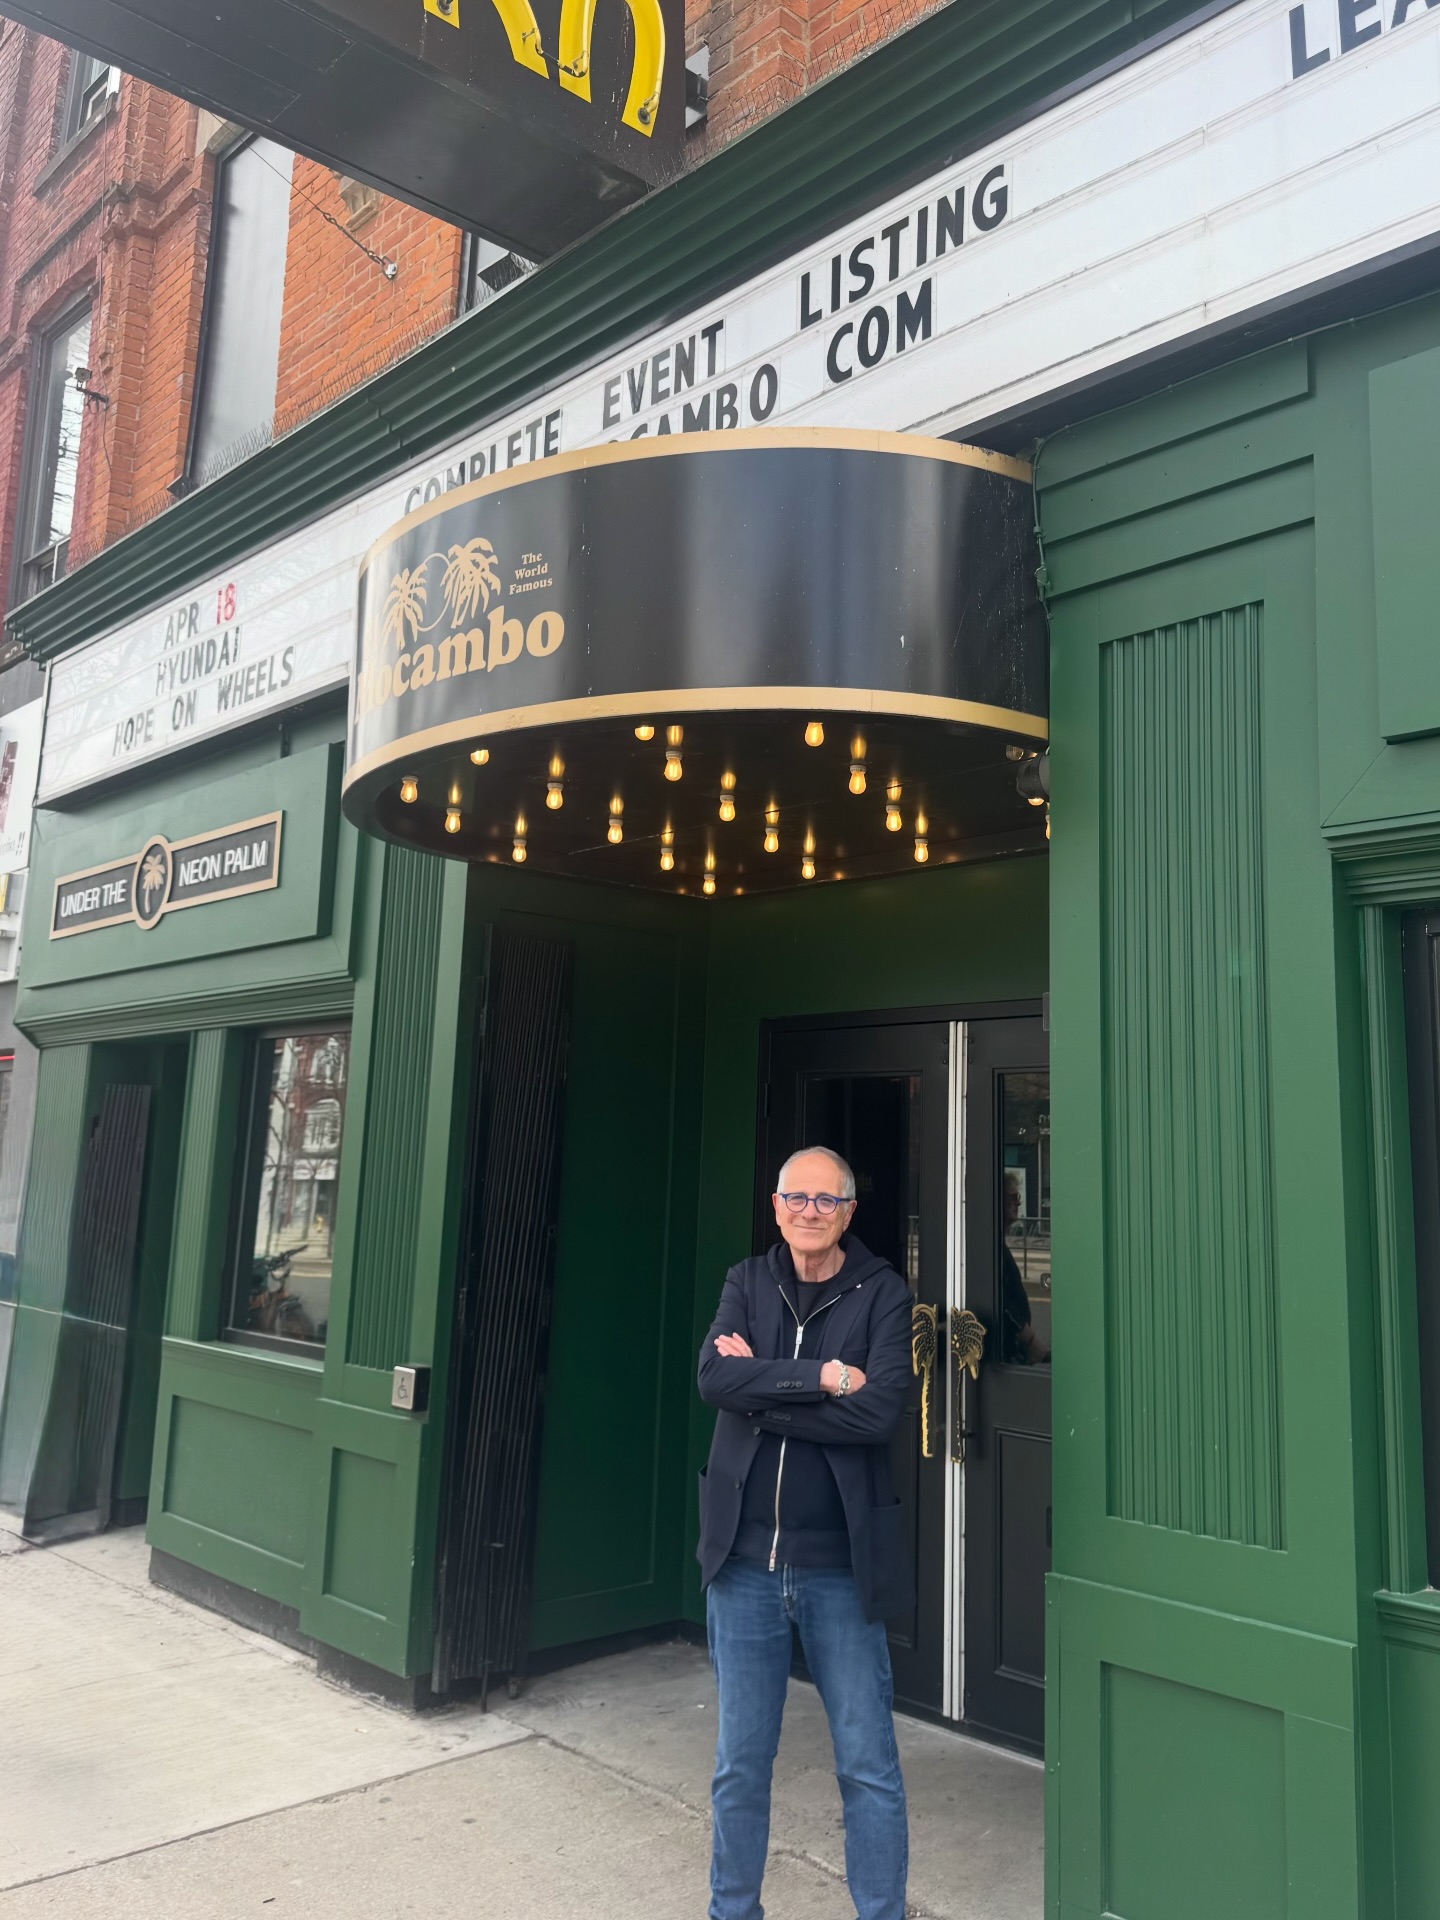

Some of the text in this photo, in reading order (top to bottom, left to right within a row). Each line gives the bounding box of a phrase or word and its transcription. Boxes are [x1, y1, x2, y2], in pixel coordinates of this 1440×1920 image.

[603, 319, 725, 431] EVENT
[800, 164, 1008, 330] LISTING
[826, 277, 932, 384] COM
[508, 577, 553, 596] Famous
[514, 562, 548, 580] World
[521, 552, 543, 565] The
[164, 583, 236, 650] APR 18
[156, 626, 240, 696] HYUNDAI
[113, 645, 294, 757] HOPE ON WHEELS
[178, 840, 269, 887] NEON PALM
[60, 879, 128, 918] UNDER THE
